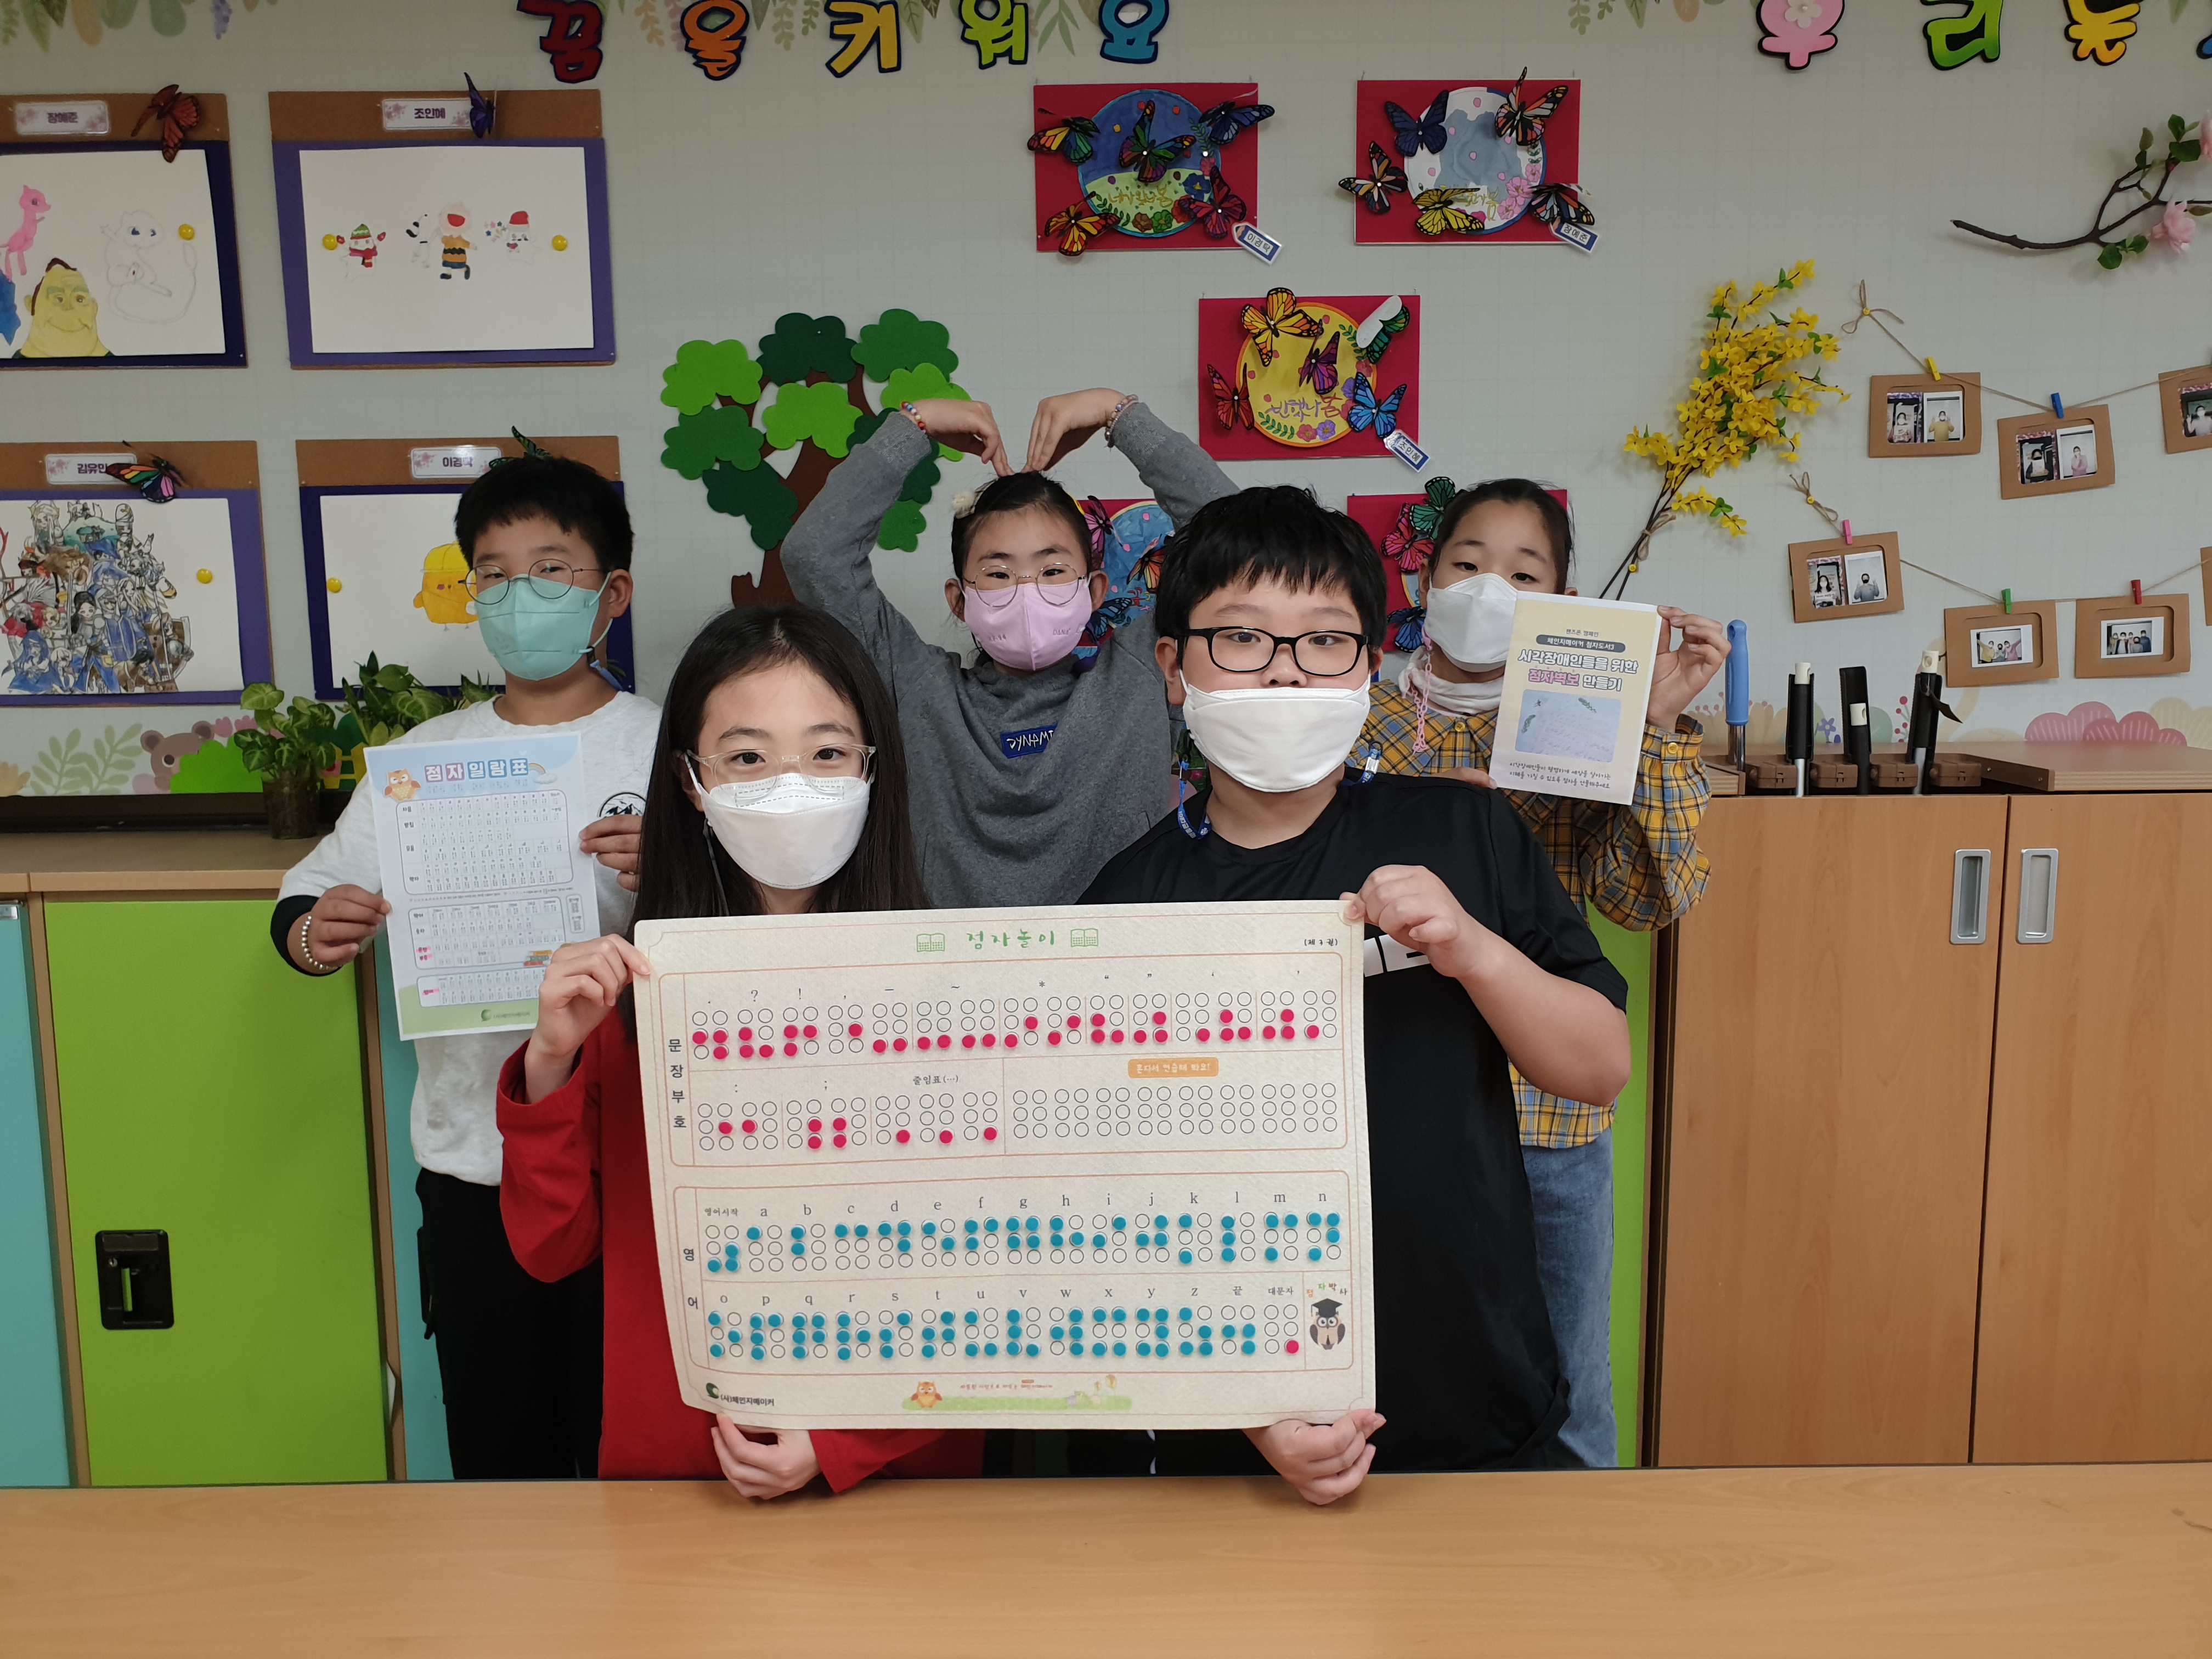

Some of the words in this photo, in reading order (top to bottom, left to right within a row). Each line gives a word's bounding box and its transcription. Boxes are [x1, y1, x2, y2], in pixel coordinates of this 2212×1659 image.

[1517, 649, 1609, 672] 시각장애인들을
[1610, 658, 1639, 674] 위한
[1528, 668, 1580, 686] 점자벽보
[1583, 675, 1623, 692] 만들기
[966, 929, 1054, 950] 점자놀이
[751, 990, 758, 1002] ?
[804, 1204, 811, 1215] b
[891, 1200, 898, 1211] d
[979, 1197, 983, 1208] f
[1020, 1199, 1027, 1209] g
[1063, 1195, 1070, 1206] h
[1108, 1193, 1110, 1205] i
[1149, 1193, 1153, 1206] j
[1190, 1192, 1198, 1203] k
[1236, 1192, 1239, 1203] l
[763, 1296, 770, 1306] p
[805, 1296, 812, 1305] q
[936, 1290, 940, 1300] t
[1148, 1289, 1155, 1299] y
[1233, 1286, 1242, 1295] 끝
[1268, 1287, 1293, 1295] 대문자
